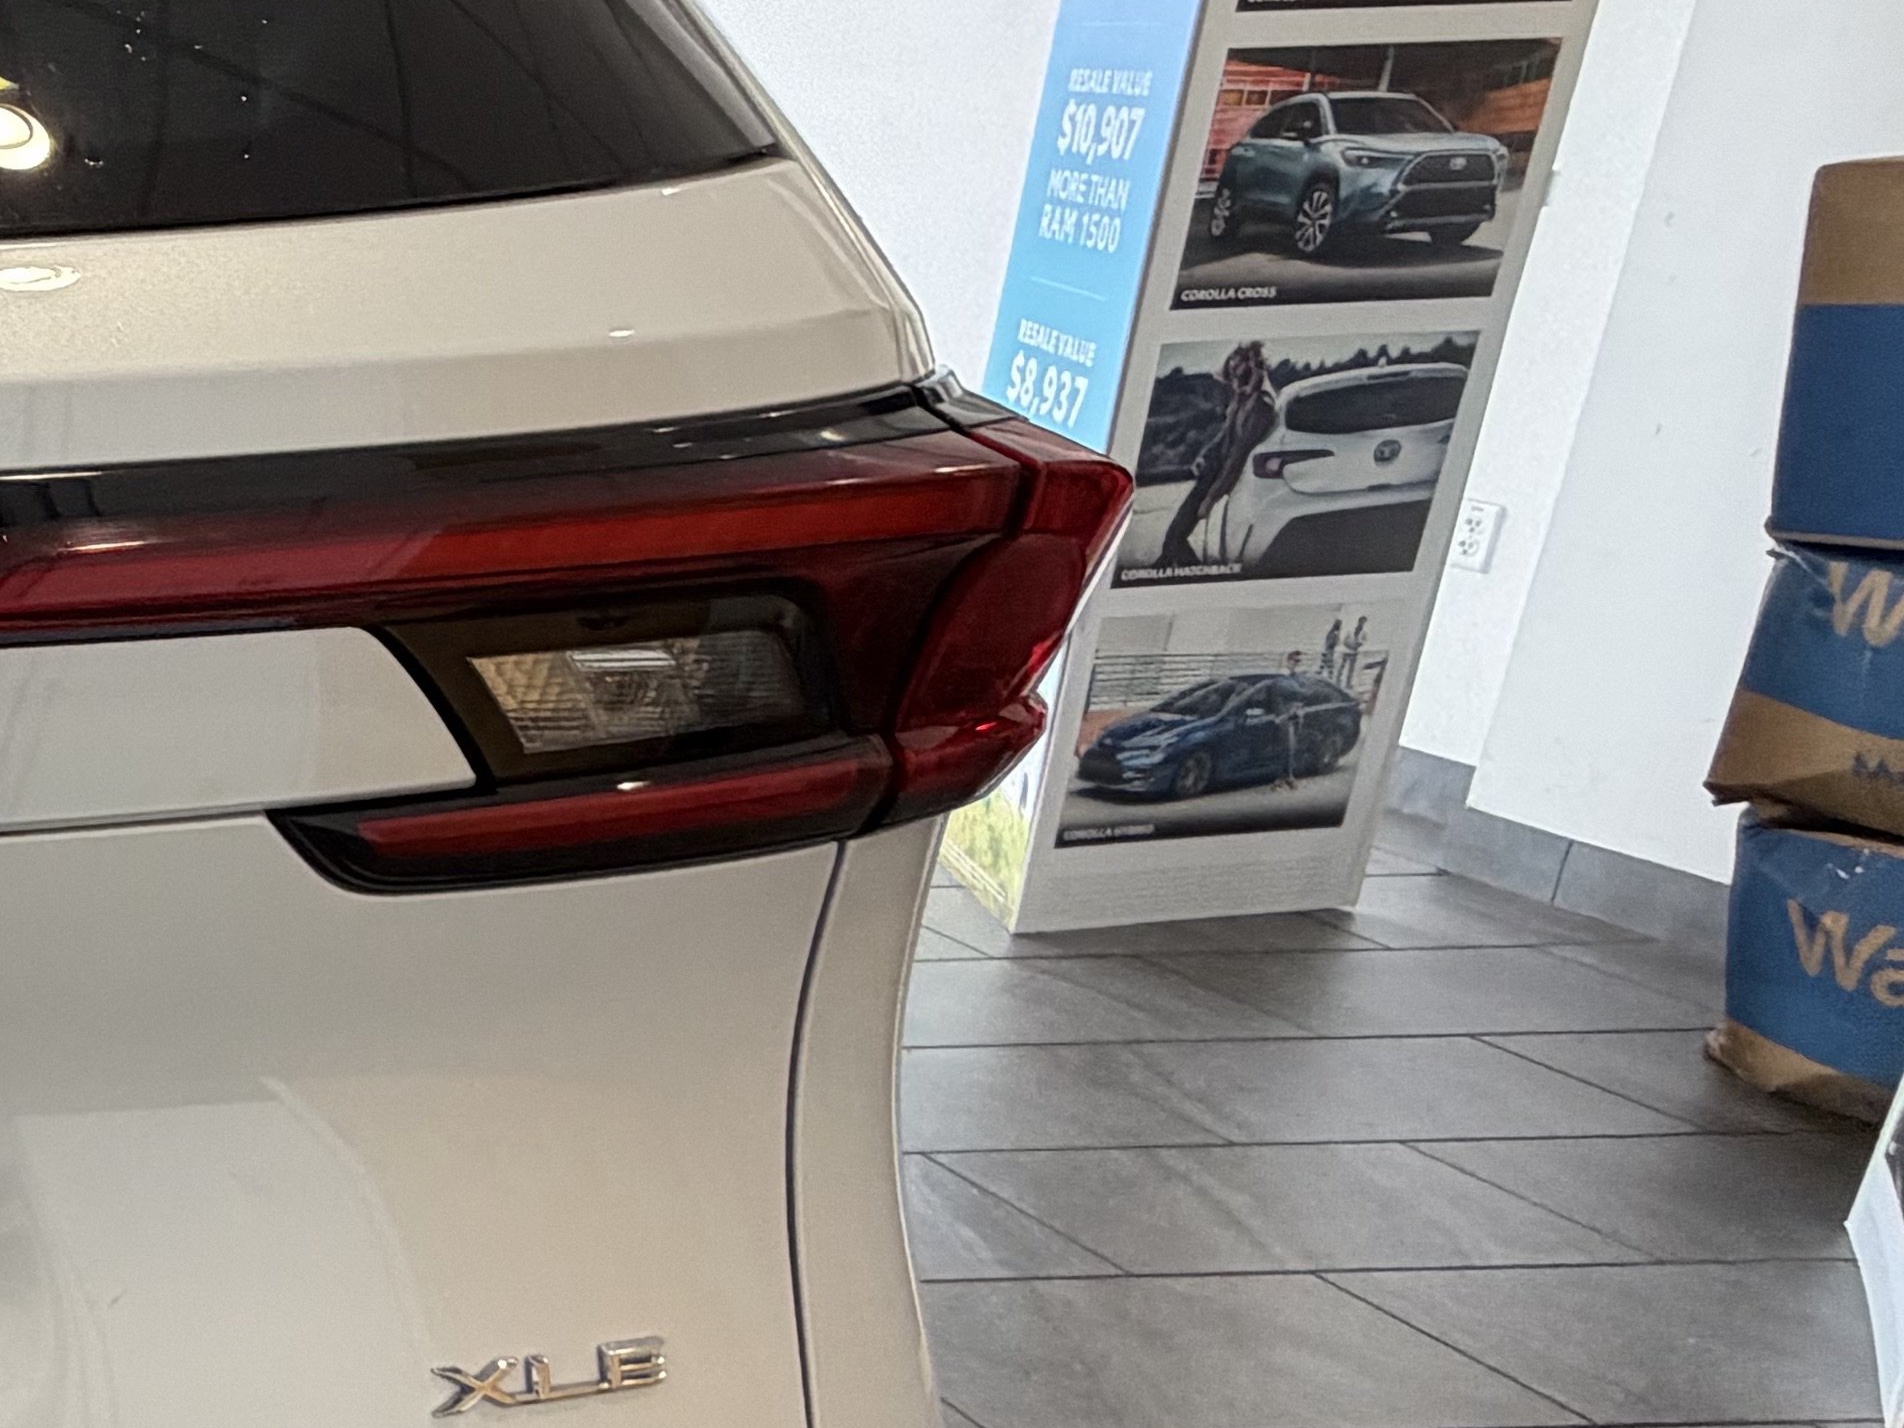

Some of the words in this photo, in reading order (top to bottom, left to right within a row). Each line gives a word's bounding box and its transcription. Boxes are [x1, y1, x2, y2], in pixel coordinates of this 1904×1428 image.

[1068, 68, 1112, 97] RESALE
[1111, 71, 1153, 98] VALUE
[1056, 98, 1146, 165] $10,907
[1047, 168, 1089, 204] MORE
[1089, 173, 1131, 212] THAN
[1038, 204, 1077, 245] RAM
[1079, 213, 1121, 254] 1500
[1180, 286, 1237, 302] COROLLA
[1017, 318, 1059, 355] RESALE
[1057, 330, 1097, 369] VALUE
[1006, 350, 1089, 429] $8,937
[430, 1335, 668, 1419] XLE
